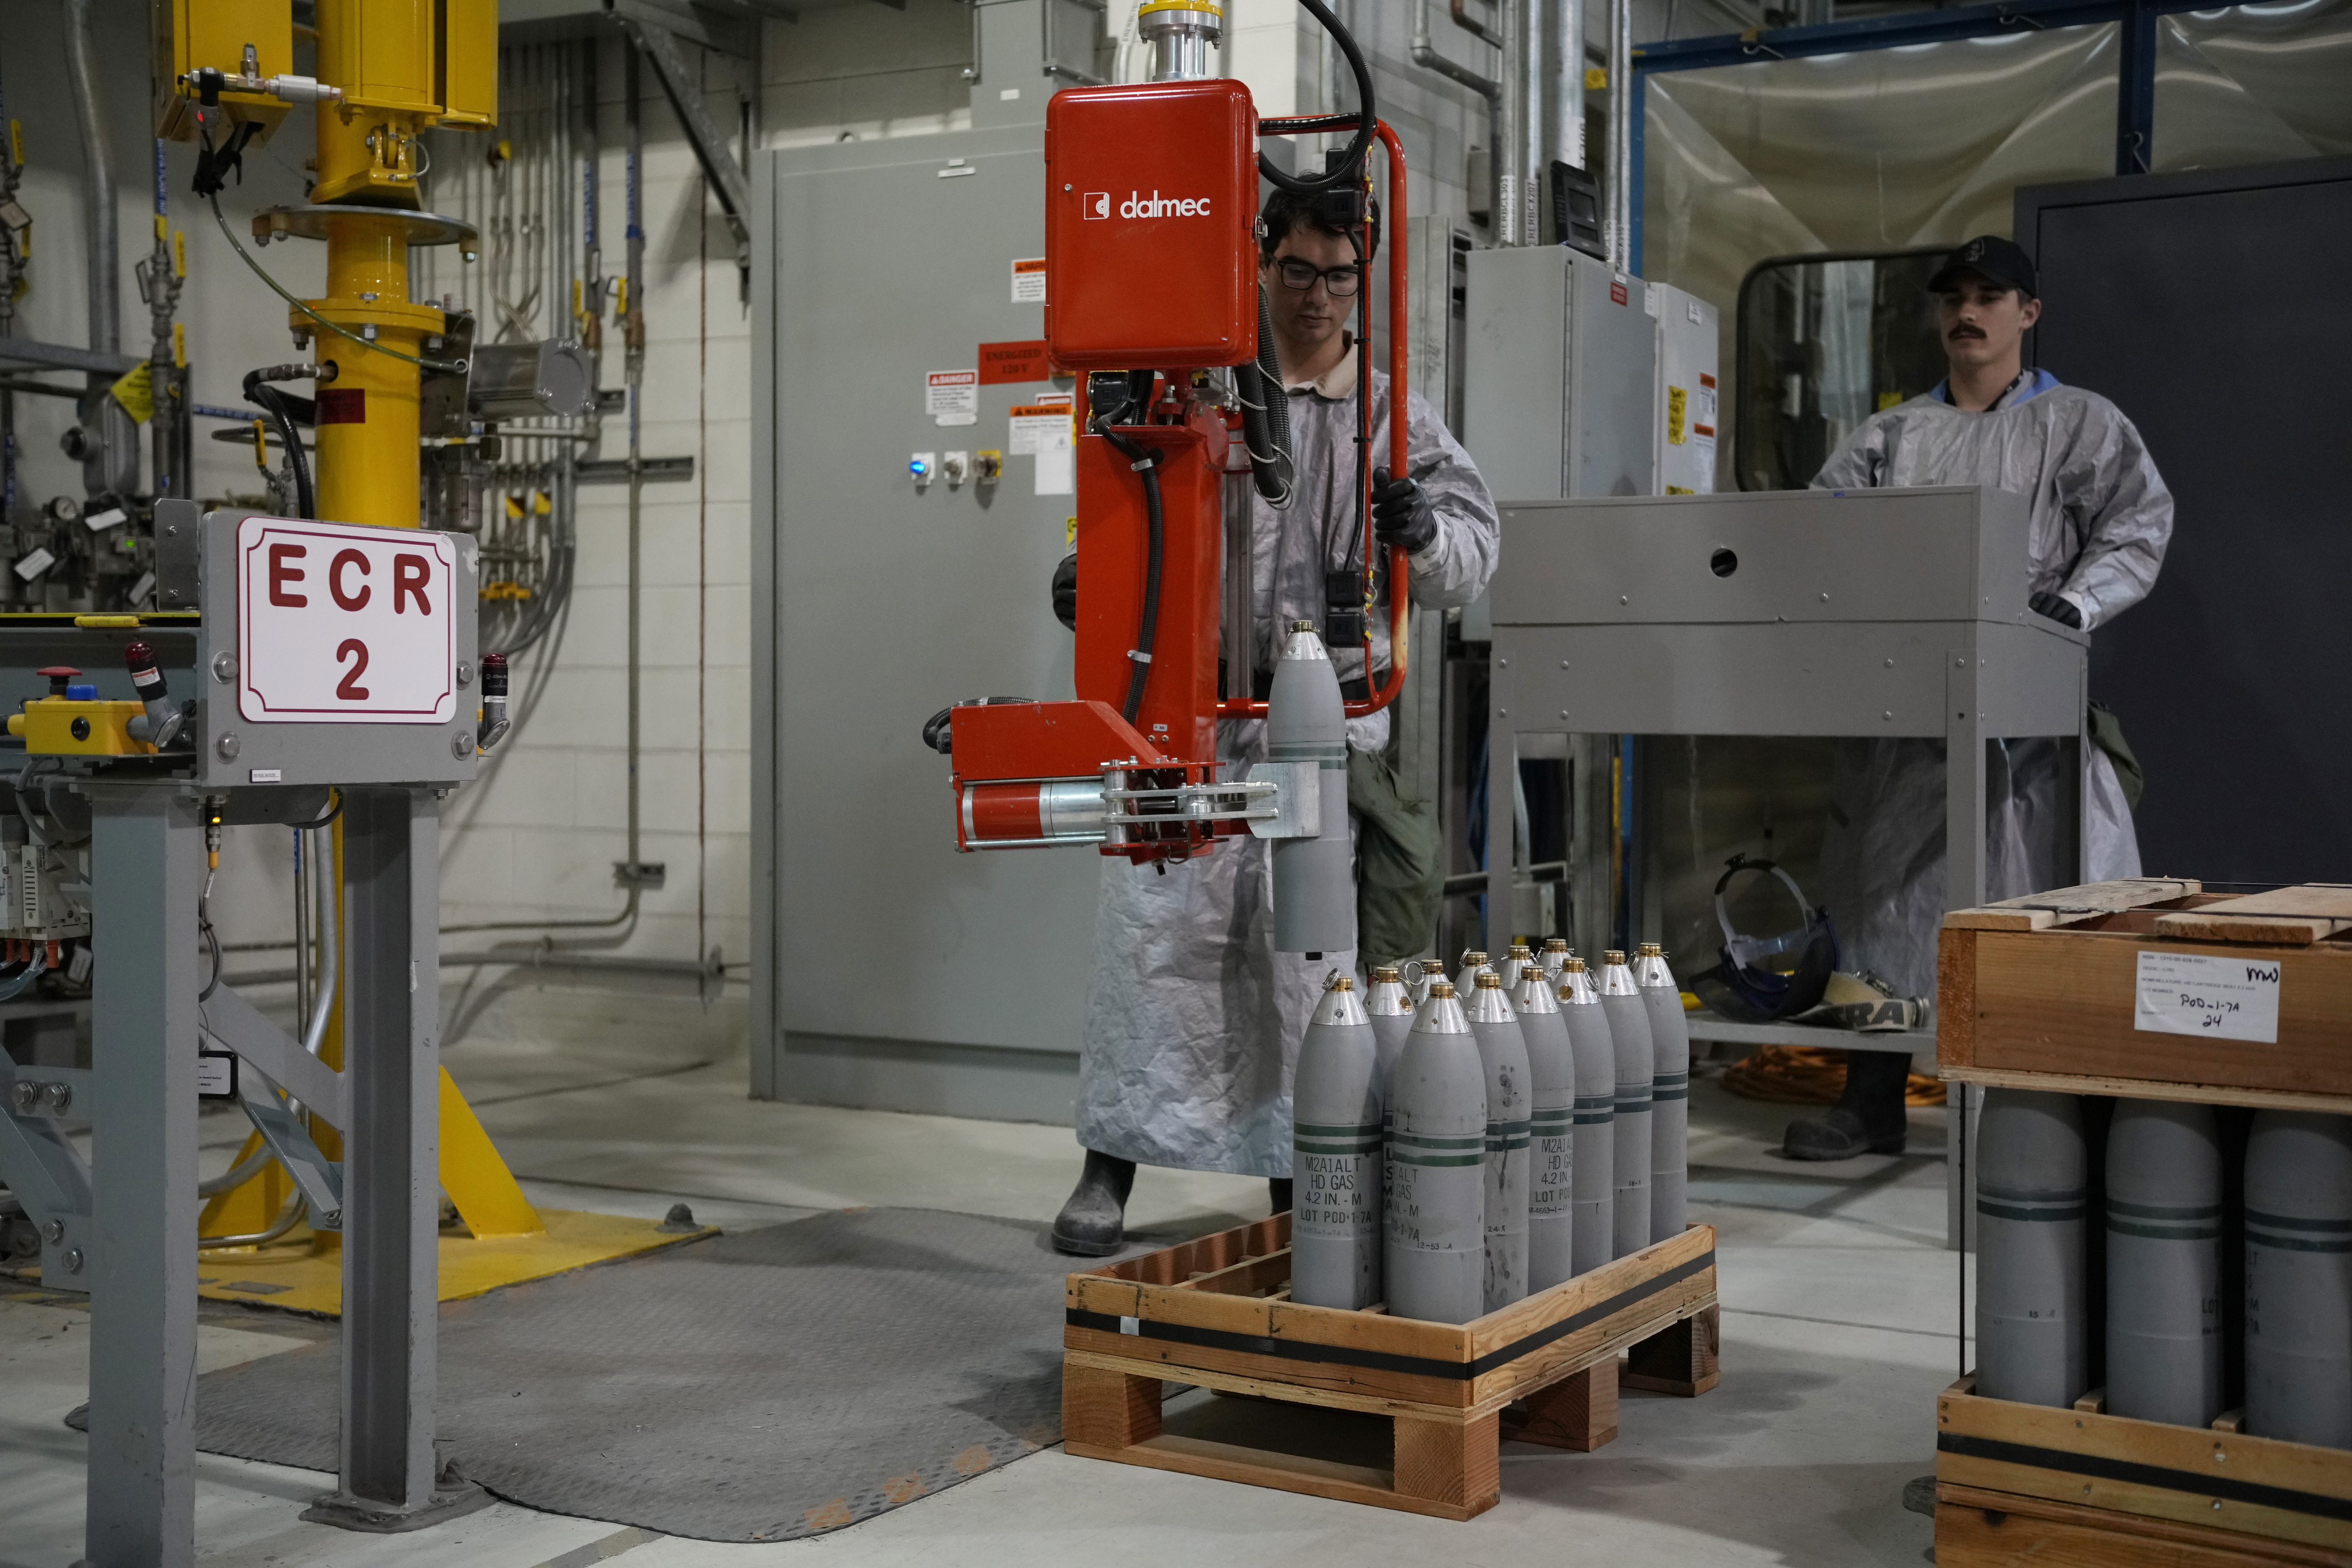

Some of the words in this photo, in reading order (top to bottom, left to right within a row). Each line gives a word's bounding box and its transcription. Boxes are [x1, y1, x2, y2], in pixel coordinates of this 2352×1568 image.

[1120, 190, 1210, 219] dalmec
[336, 639, 369, 700] 2
[2203, 1015, 2221, 1027] 24
[1548, 1155, 1560, 1169] HD
[1311, 1174, 1325, 1189] HD
[1331, 1174, 1354, 1190] GAS
[1541, 1172, 1557, 1184] 4.2
[1305, 1191, 1320, 1204] 4.2
[1351, 1193, 1361, 1206] M
[1535, 1190, 1554, 1203] LOT
[1301, 1208, 1318, 1222] LOT
[1410, 1204, 1418, 1217] M
